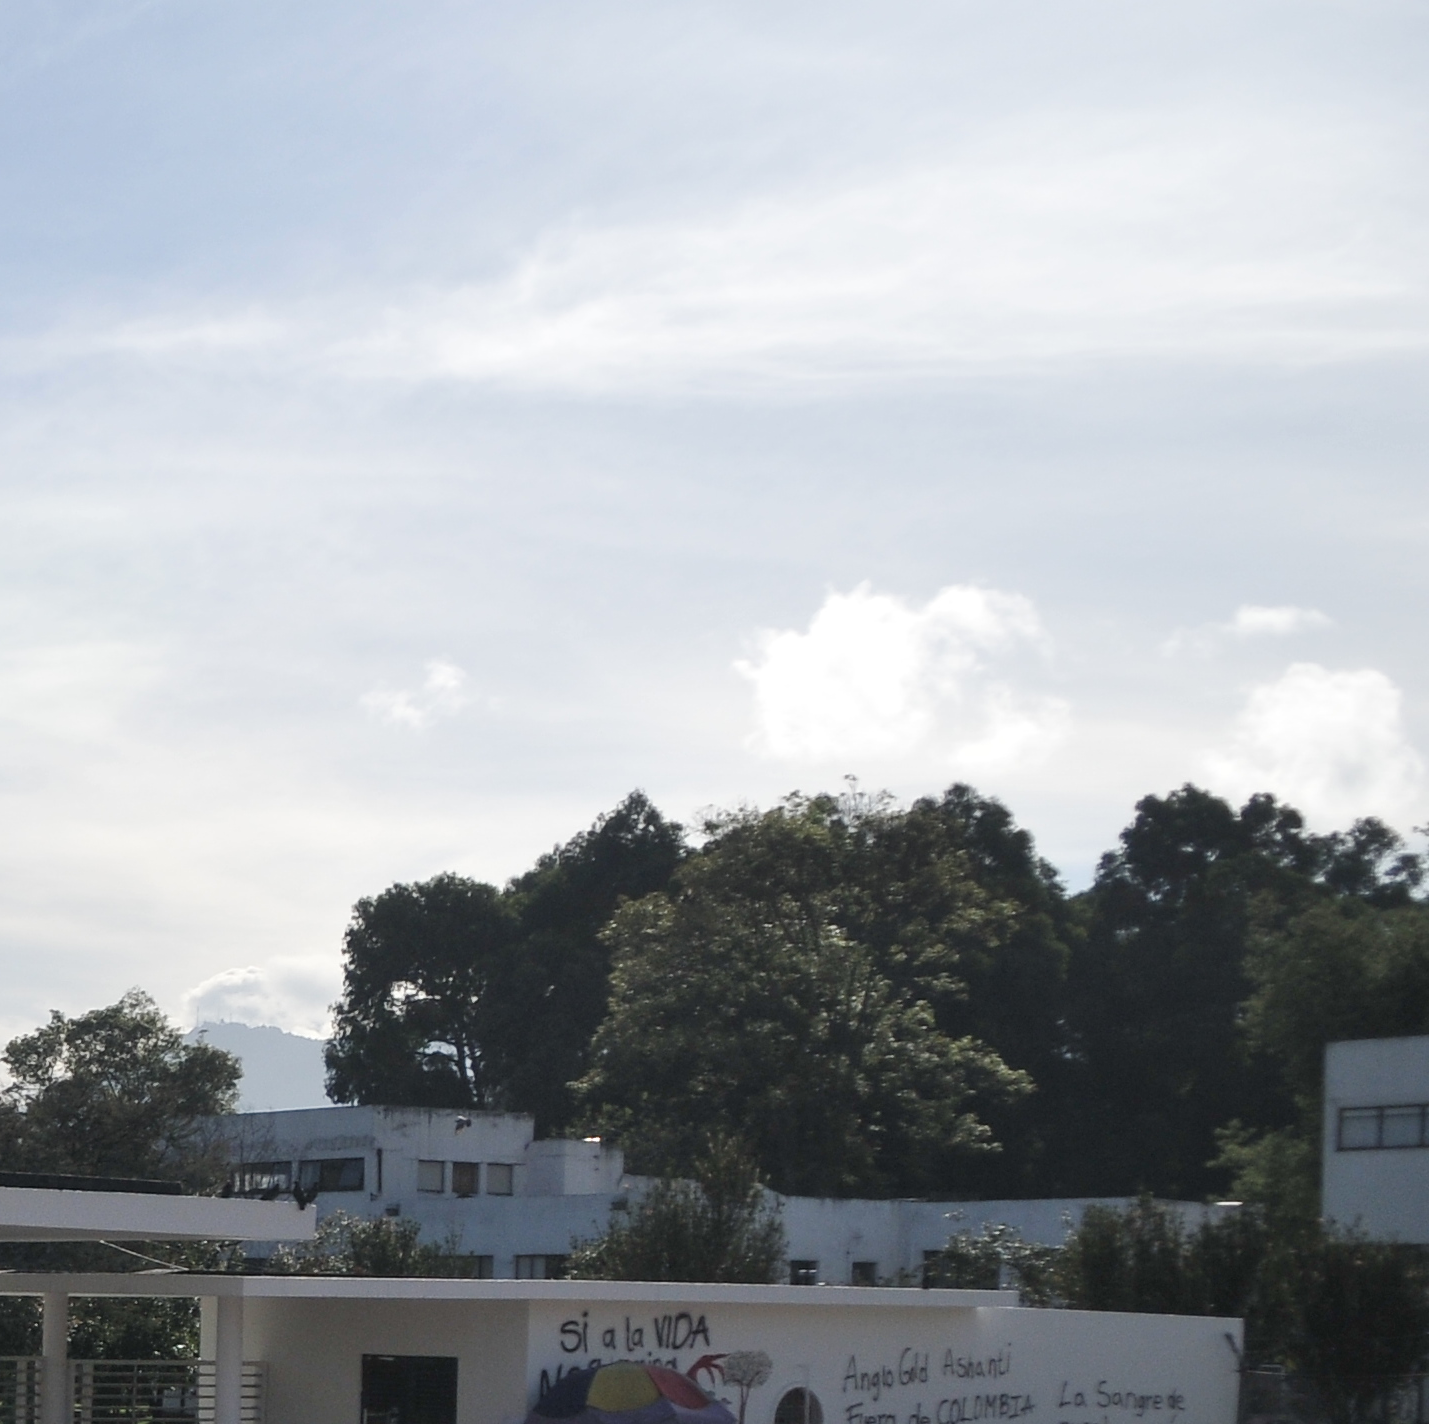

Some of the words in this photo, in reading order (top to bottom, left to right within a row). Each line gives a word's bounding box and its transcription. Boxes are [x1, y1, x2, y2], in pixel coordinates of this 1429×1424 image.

[602, 1330, 616, 1351] a
[626, 1317, 644, 1351] la
[654, 1312, 710, 1351] VIDA
[842, 1355, 894, 1402] Anglo
[943, 1342, 1012, 1380] Ashanti
[1058, 1380, 1087, 1409] La
[1096, 1380, 1162, 1416] Sangre
[1168, 1389, 1186, 1411] de
